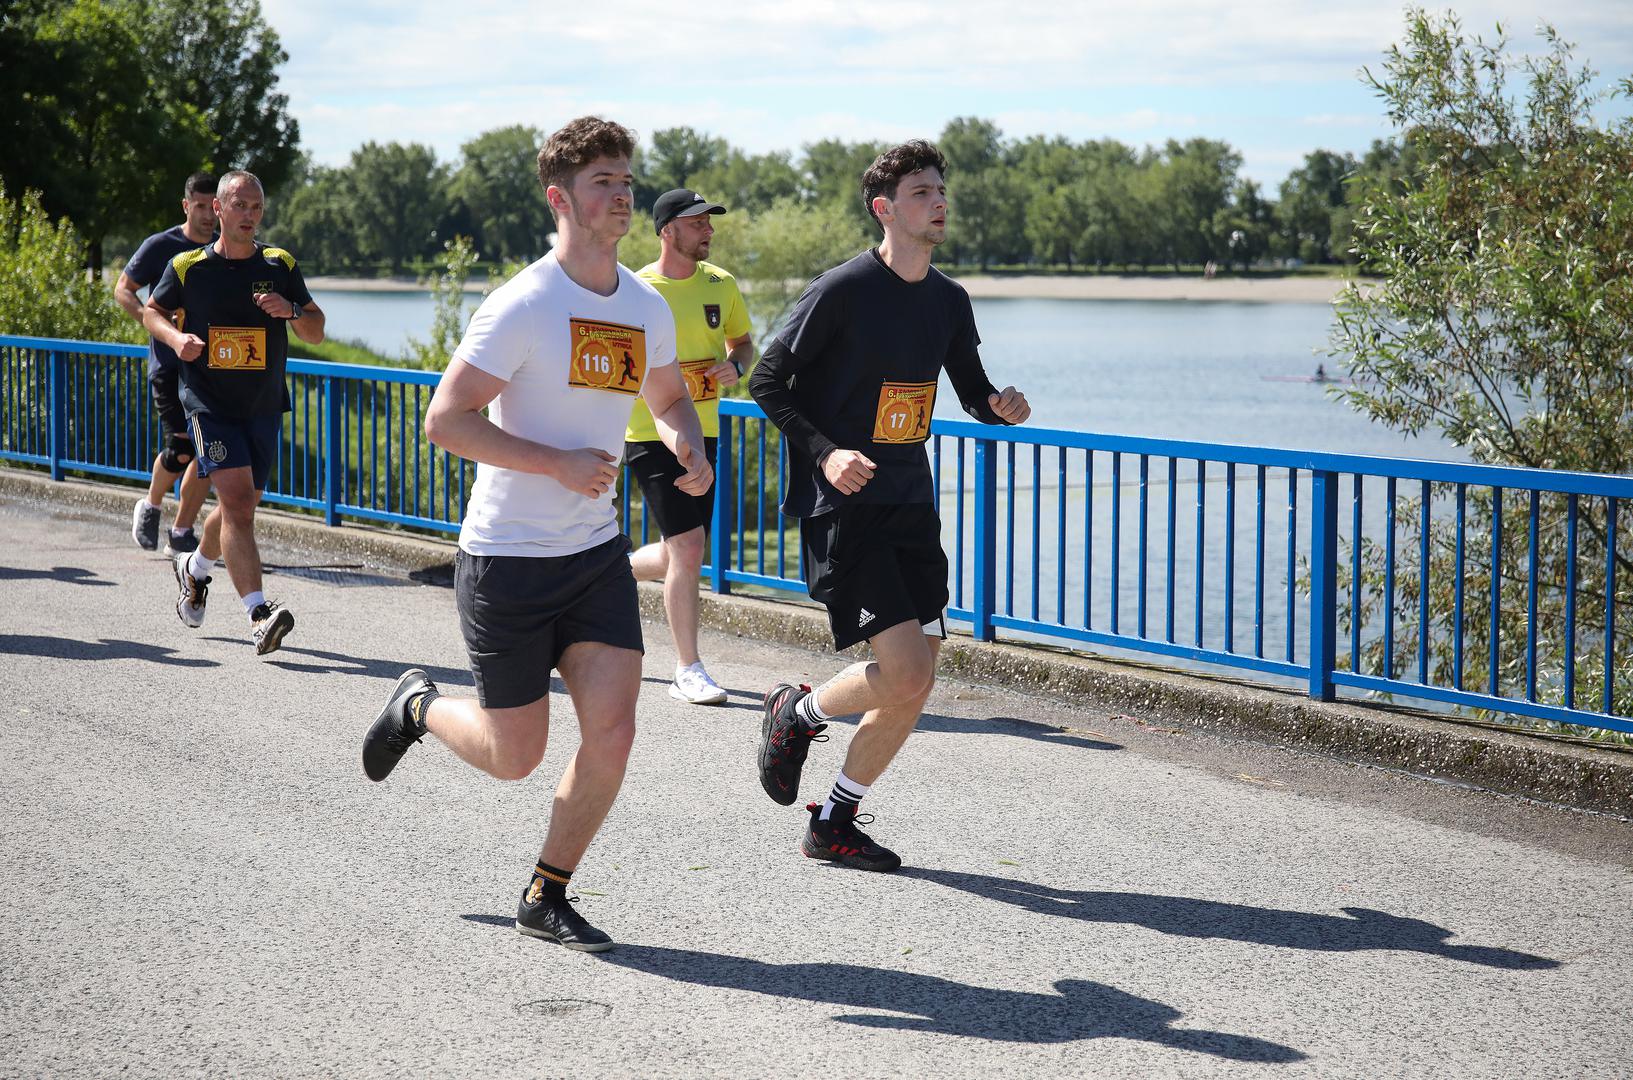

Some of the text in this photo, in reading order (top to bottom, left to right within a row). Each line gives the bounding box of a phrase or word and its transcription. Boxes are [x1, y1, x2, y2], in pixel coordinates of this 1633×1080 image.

[579, 326, 589, 336] 6.
[219, 347, 232, 359] 51
[582, 352, 610, 374] 116
[890, 412, 907, 429] 17
